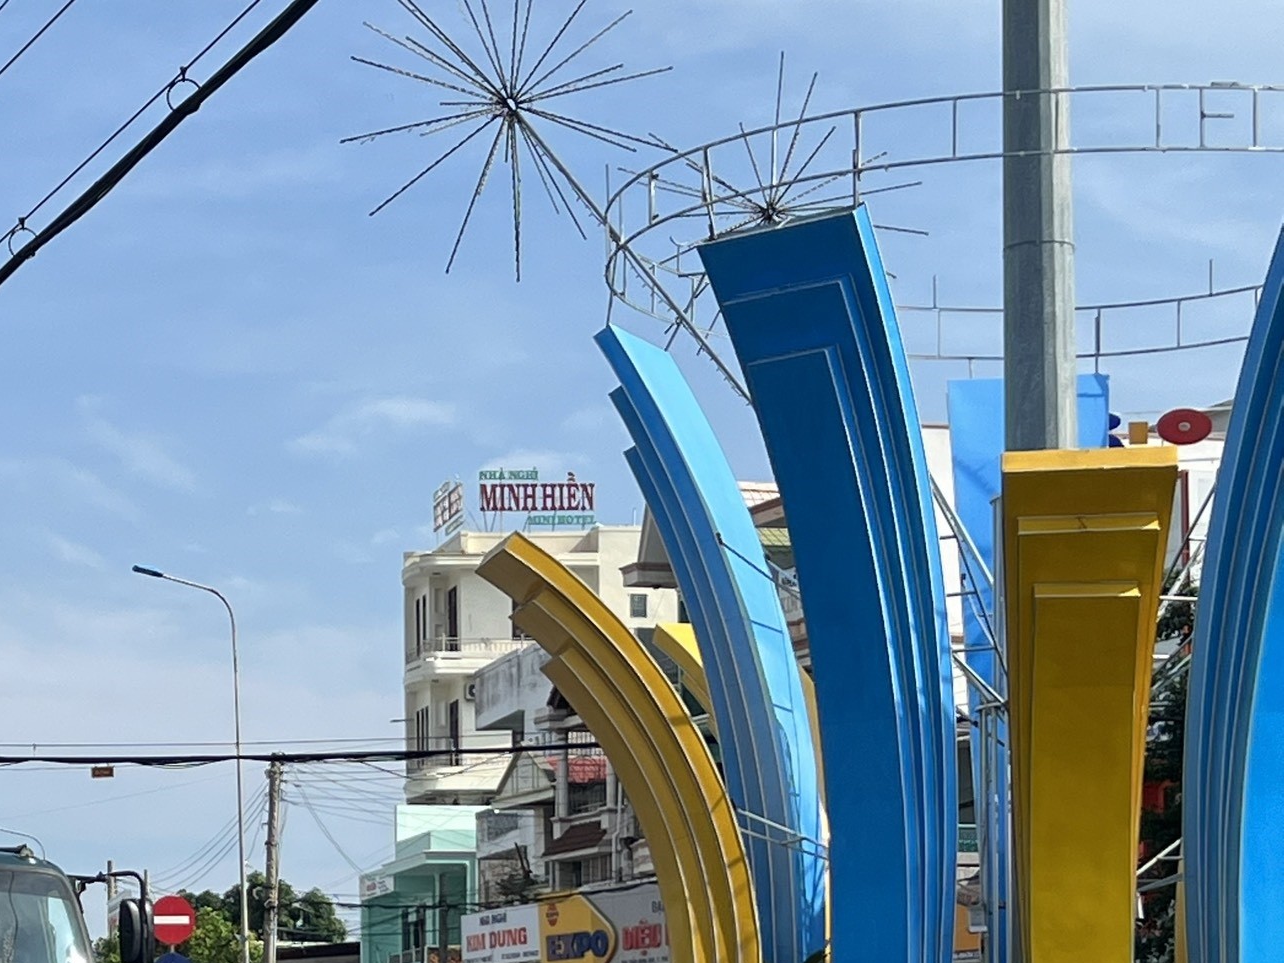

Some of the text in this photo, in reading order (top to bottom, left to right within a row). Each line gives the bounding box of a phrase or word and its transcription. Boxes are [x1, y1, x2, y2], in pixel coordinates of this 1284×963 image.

[480, 483, 538, 511] MINH
[540, 472, 595, 511] HIỀN
[466, 927, 528, 953] KIM DUNG
[546, 930, 609, 962] EXPO
